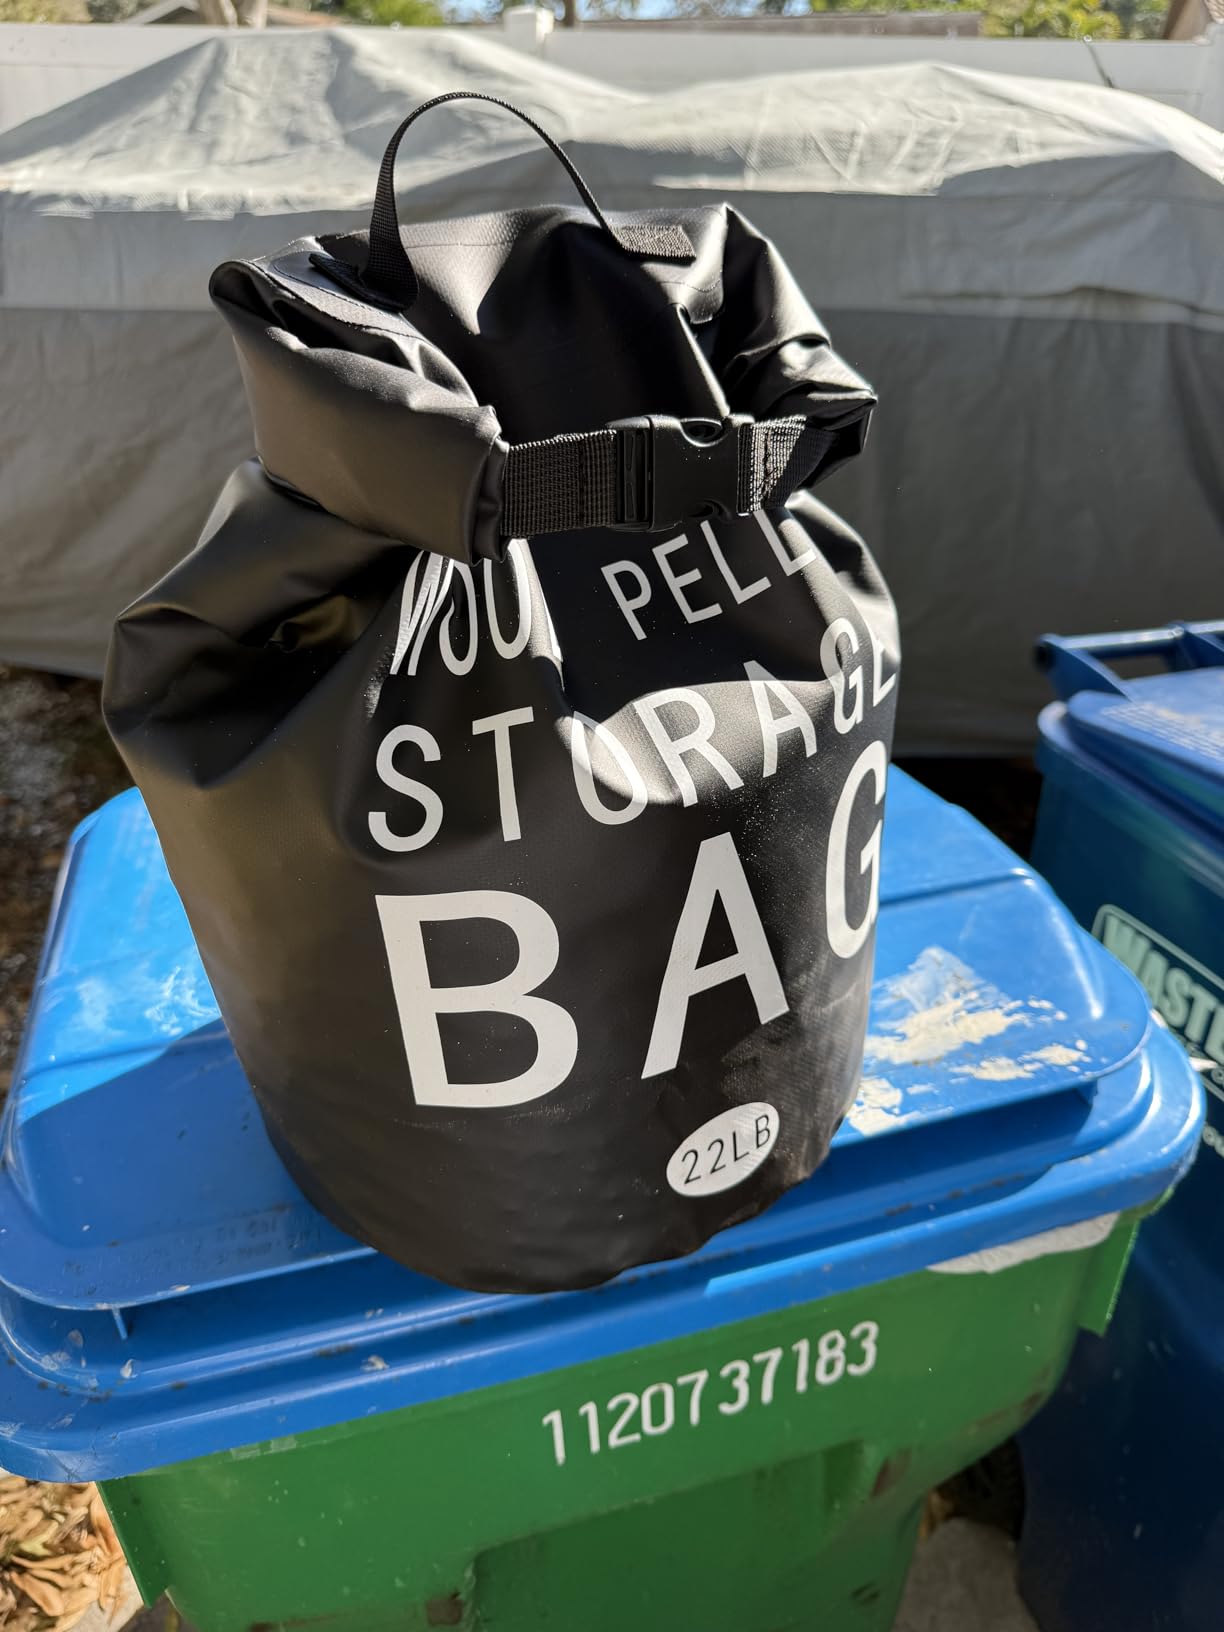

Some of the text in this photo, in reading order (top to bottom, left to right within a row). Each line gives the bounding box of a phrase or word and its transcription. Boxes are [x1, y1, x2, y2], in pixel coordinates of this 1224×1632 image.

[389, 538, 563, 676] WOO
[375, 740, 887, 1108] BAG
[681, 1113, 771, 1185] 22LB
[542, 1321, 879, 1466] 1120737183
